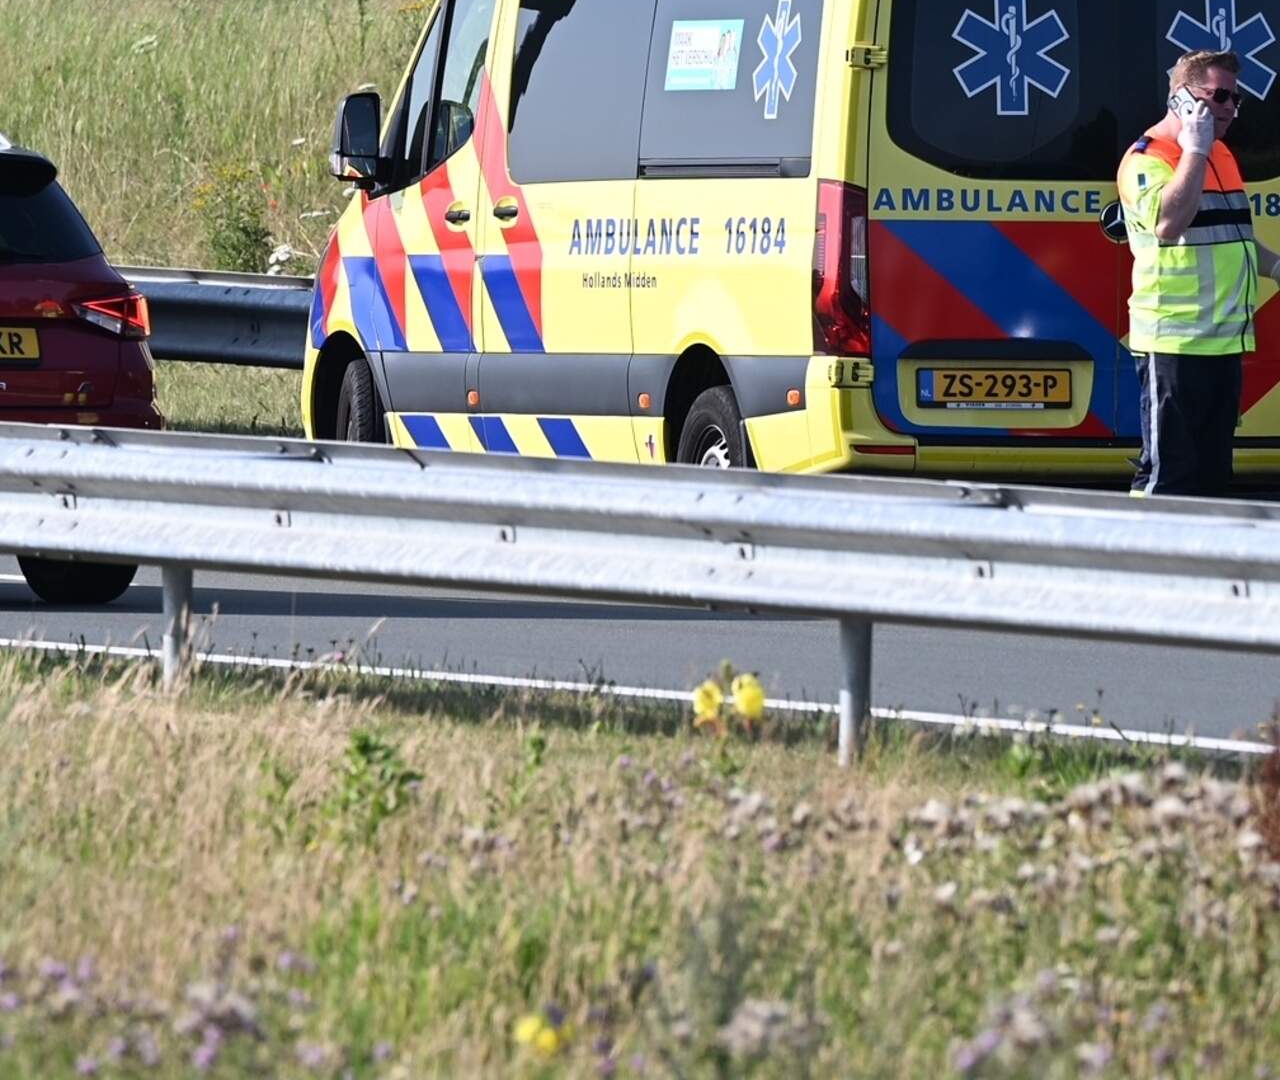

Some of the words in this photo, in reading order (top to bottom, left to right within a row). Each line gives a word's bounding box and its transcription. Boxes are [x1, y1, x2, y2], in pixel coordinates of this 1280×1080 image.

[873, 187, 1102, 213] AMBULANCE
[569, 218, 700, 256] AMBULANCE
[724, 217, 787, 255] 16184
[582, 272, 622, 289] Hollands
[624, 272, 658, 289] Midden
[920, 389, 932, 398] NL
[942, 373, 1058, 398] ZS-293-P
